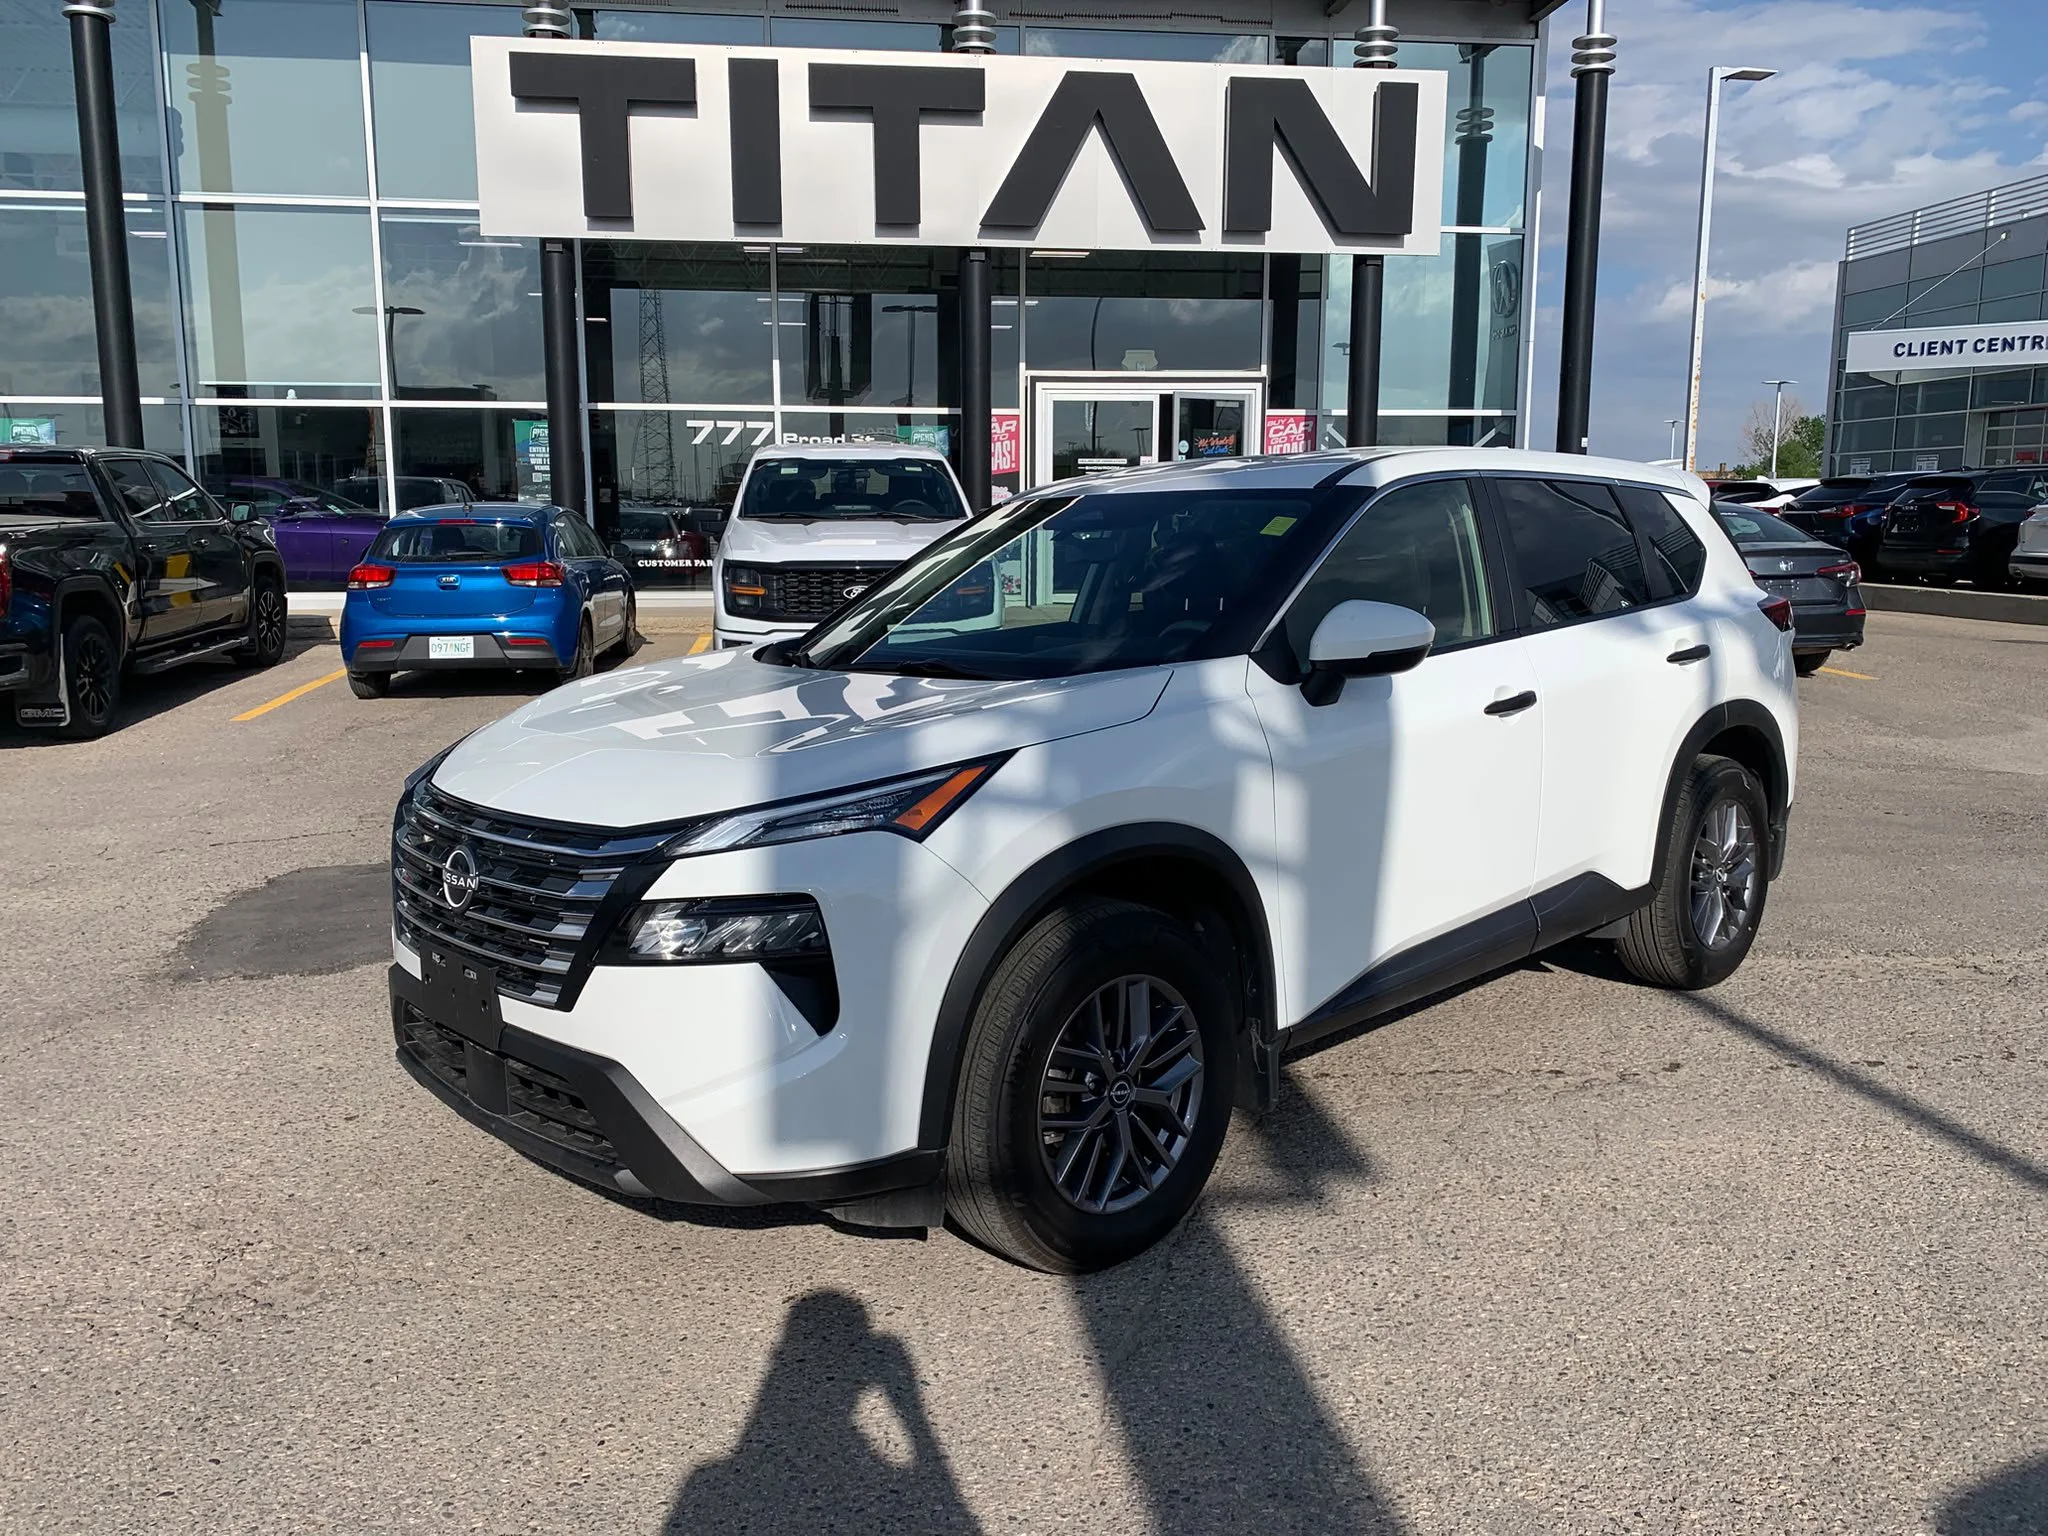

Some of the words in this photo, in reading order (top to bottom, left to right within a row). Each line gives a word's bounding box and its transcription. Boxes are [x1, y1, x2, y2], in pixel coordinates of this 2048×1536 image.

[509, 51, 1419, 236] TITAN
[1893, 339, 1968, 358] CLIENT
[1973, 334, 2048, 353] CENTR
[992, 420, 1017, 434] AR
[1267, 419, 1286, 427] BUY
[1269, 421, 1313, 438] CAR
[686, 420, 774, 446] 777
[782, 432, 846, 445] Broad
[1271, 436, 1288, 445] GO
[1289, 433, 1305, 442] TO
[637, 559, 692, 567] CUSTOMER
[454, 642, 471, 653] NGF
[20, 708, 65, 717] GMC
